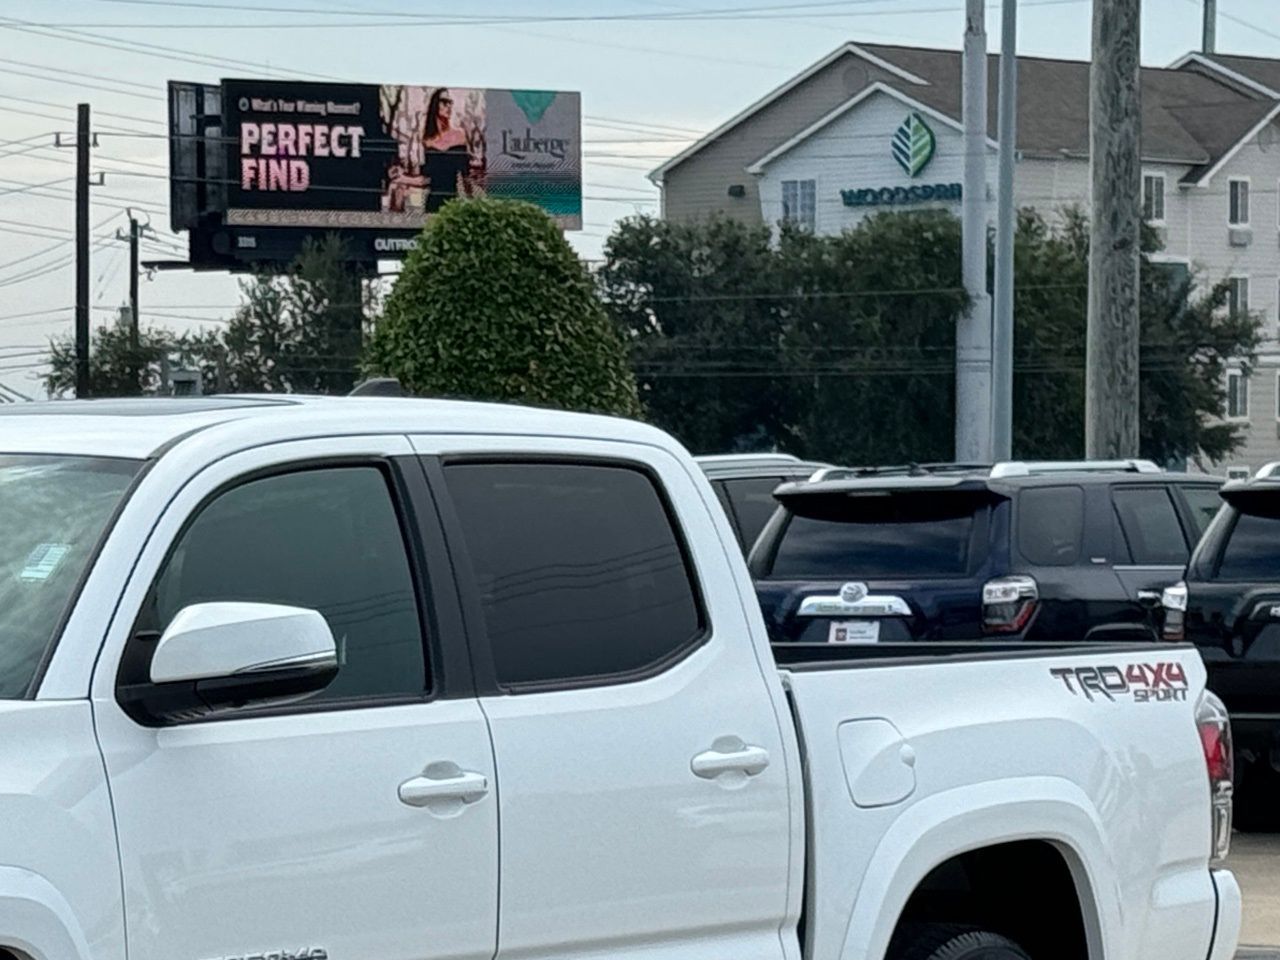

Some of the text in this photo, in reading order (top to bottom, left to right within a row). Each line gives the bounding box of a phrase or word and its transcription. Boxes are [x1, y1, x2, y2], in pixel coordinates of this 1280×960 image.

[240, 122, 365, 158] PERFECT
[241, 158, 310, 191] FIND
[374, 238, 417, 251] OUTFRO
[1049, 666, 1130, 702] TRD
[1134, 687, 1188, 702] SPORT
